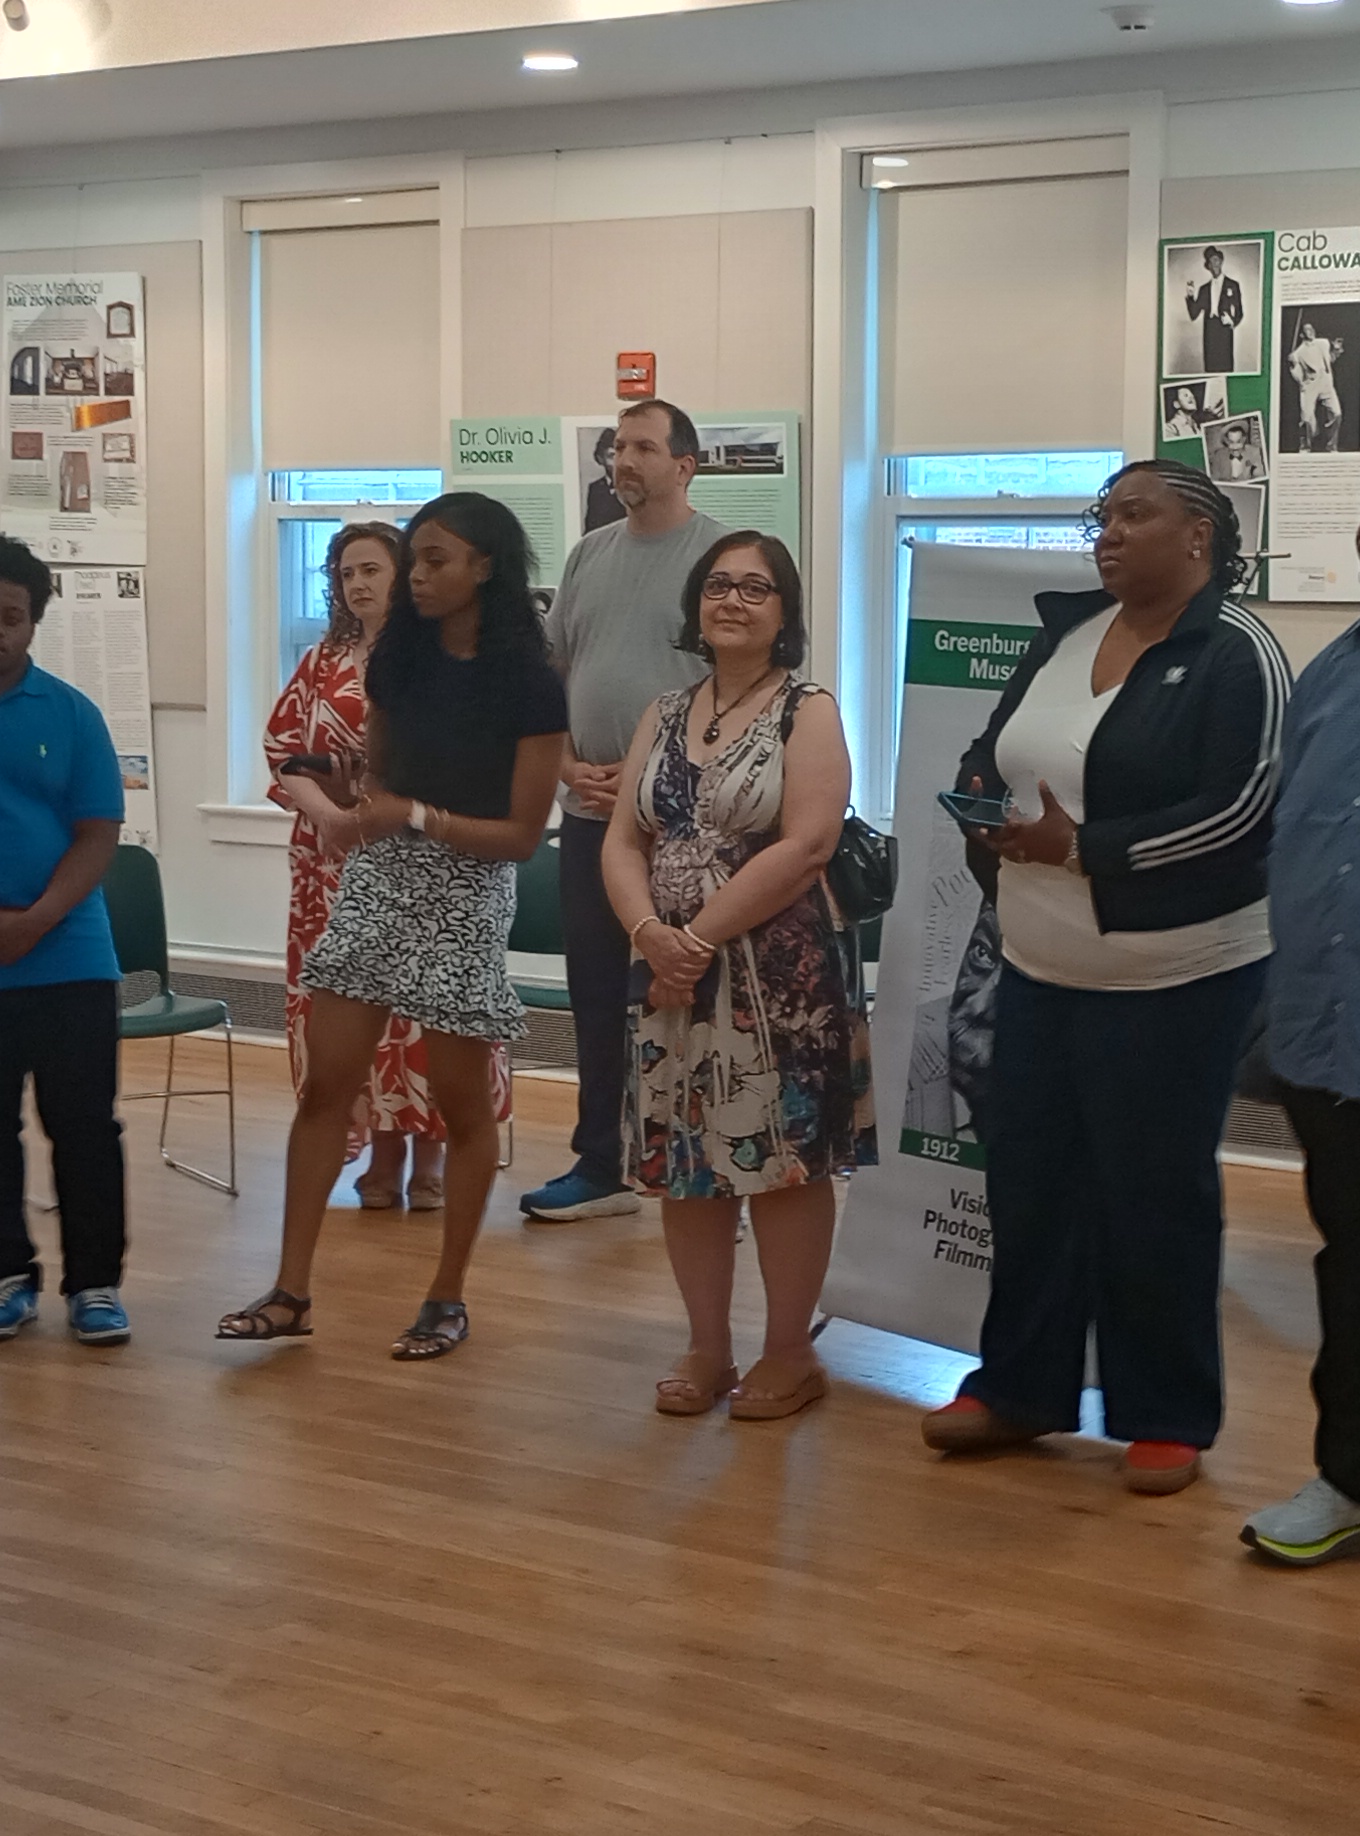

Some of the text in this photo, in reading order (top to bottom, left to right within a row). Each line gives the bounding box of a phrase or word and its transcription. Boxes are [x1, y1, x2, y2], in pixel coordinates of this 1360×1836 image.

[1277, 230, 1328, 253] Cab
[6, 280, 104, 296] Foster Memorial
[6, 295, 98, 307] AME ZION CHURCH
[459, 426, 552, 446] Dr. Olivia J.
[460, 450, 514, 464] HOOKER
[920, 1137, 961, 1162] 1912
